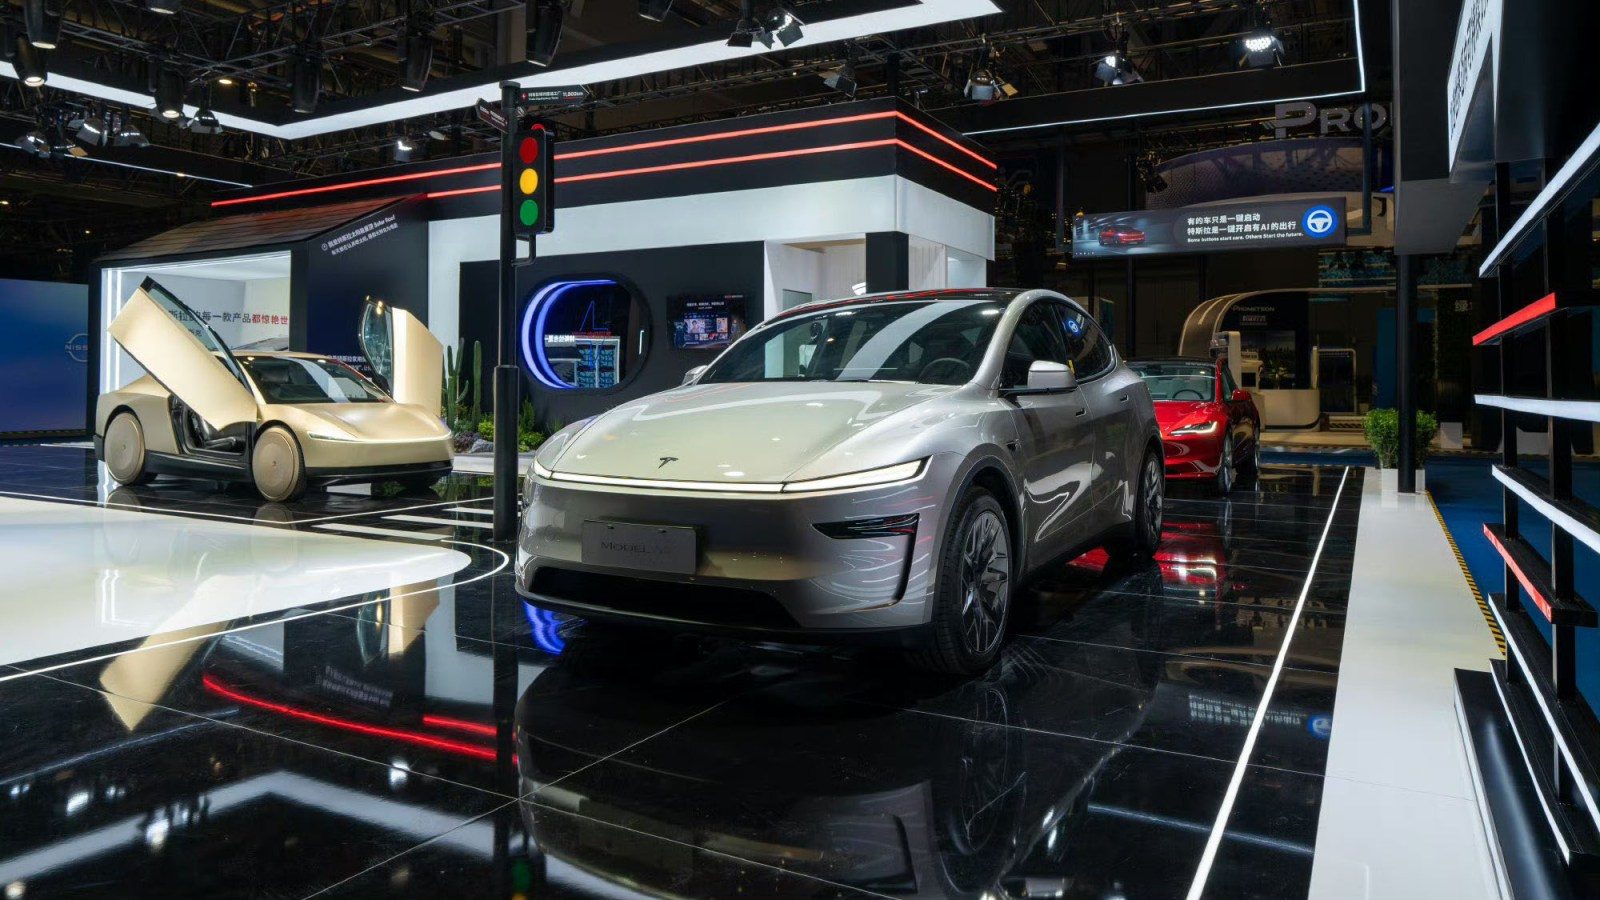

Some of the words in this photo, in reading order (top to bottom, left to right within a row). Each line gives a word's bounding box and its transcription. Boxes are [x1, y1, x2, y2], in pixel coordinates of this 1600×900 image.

[1263, 101, 1393, 139] PRO
[1187, 213, 1261, 226] 有的车只是一键启动
